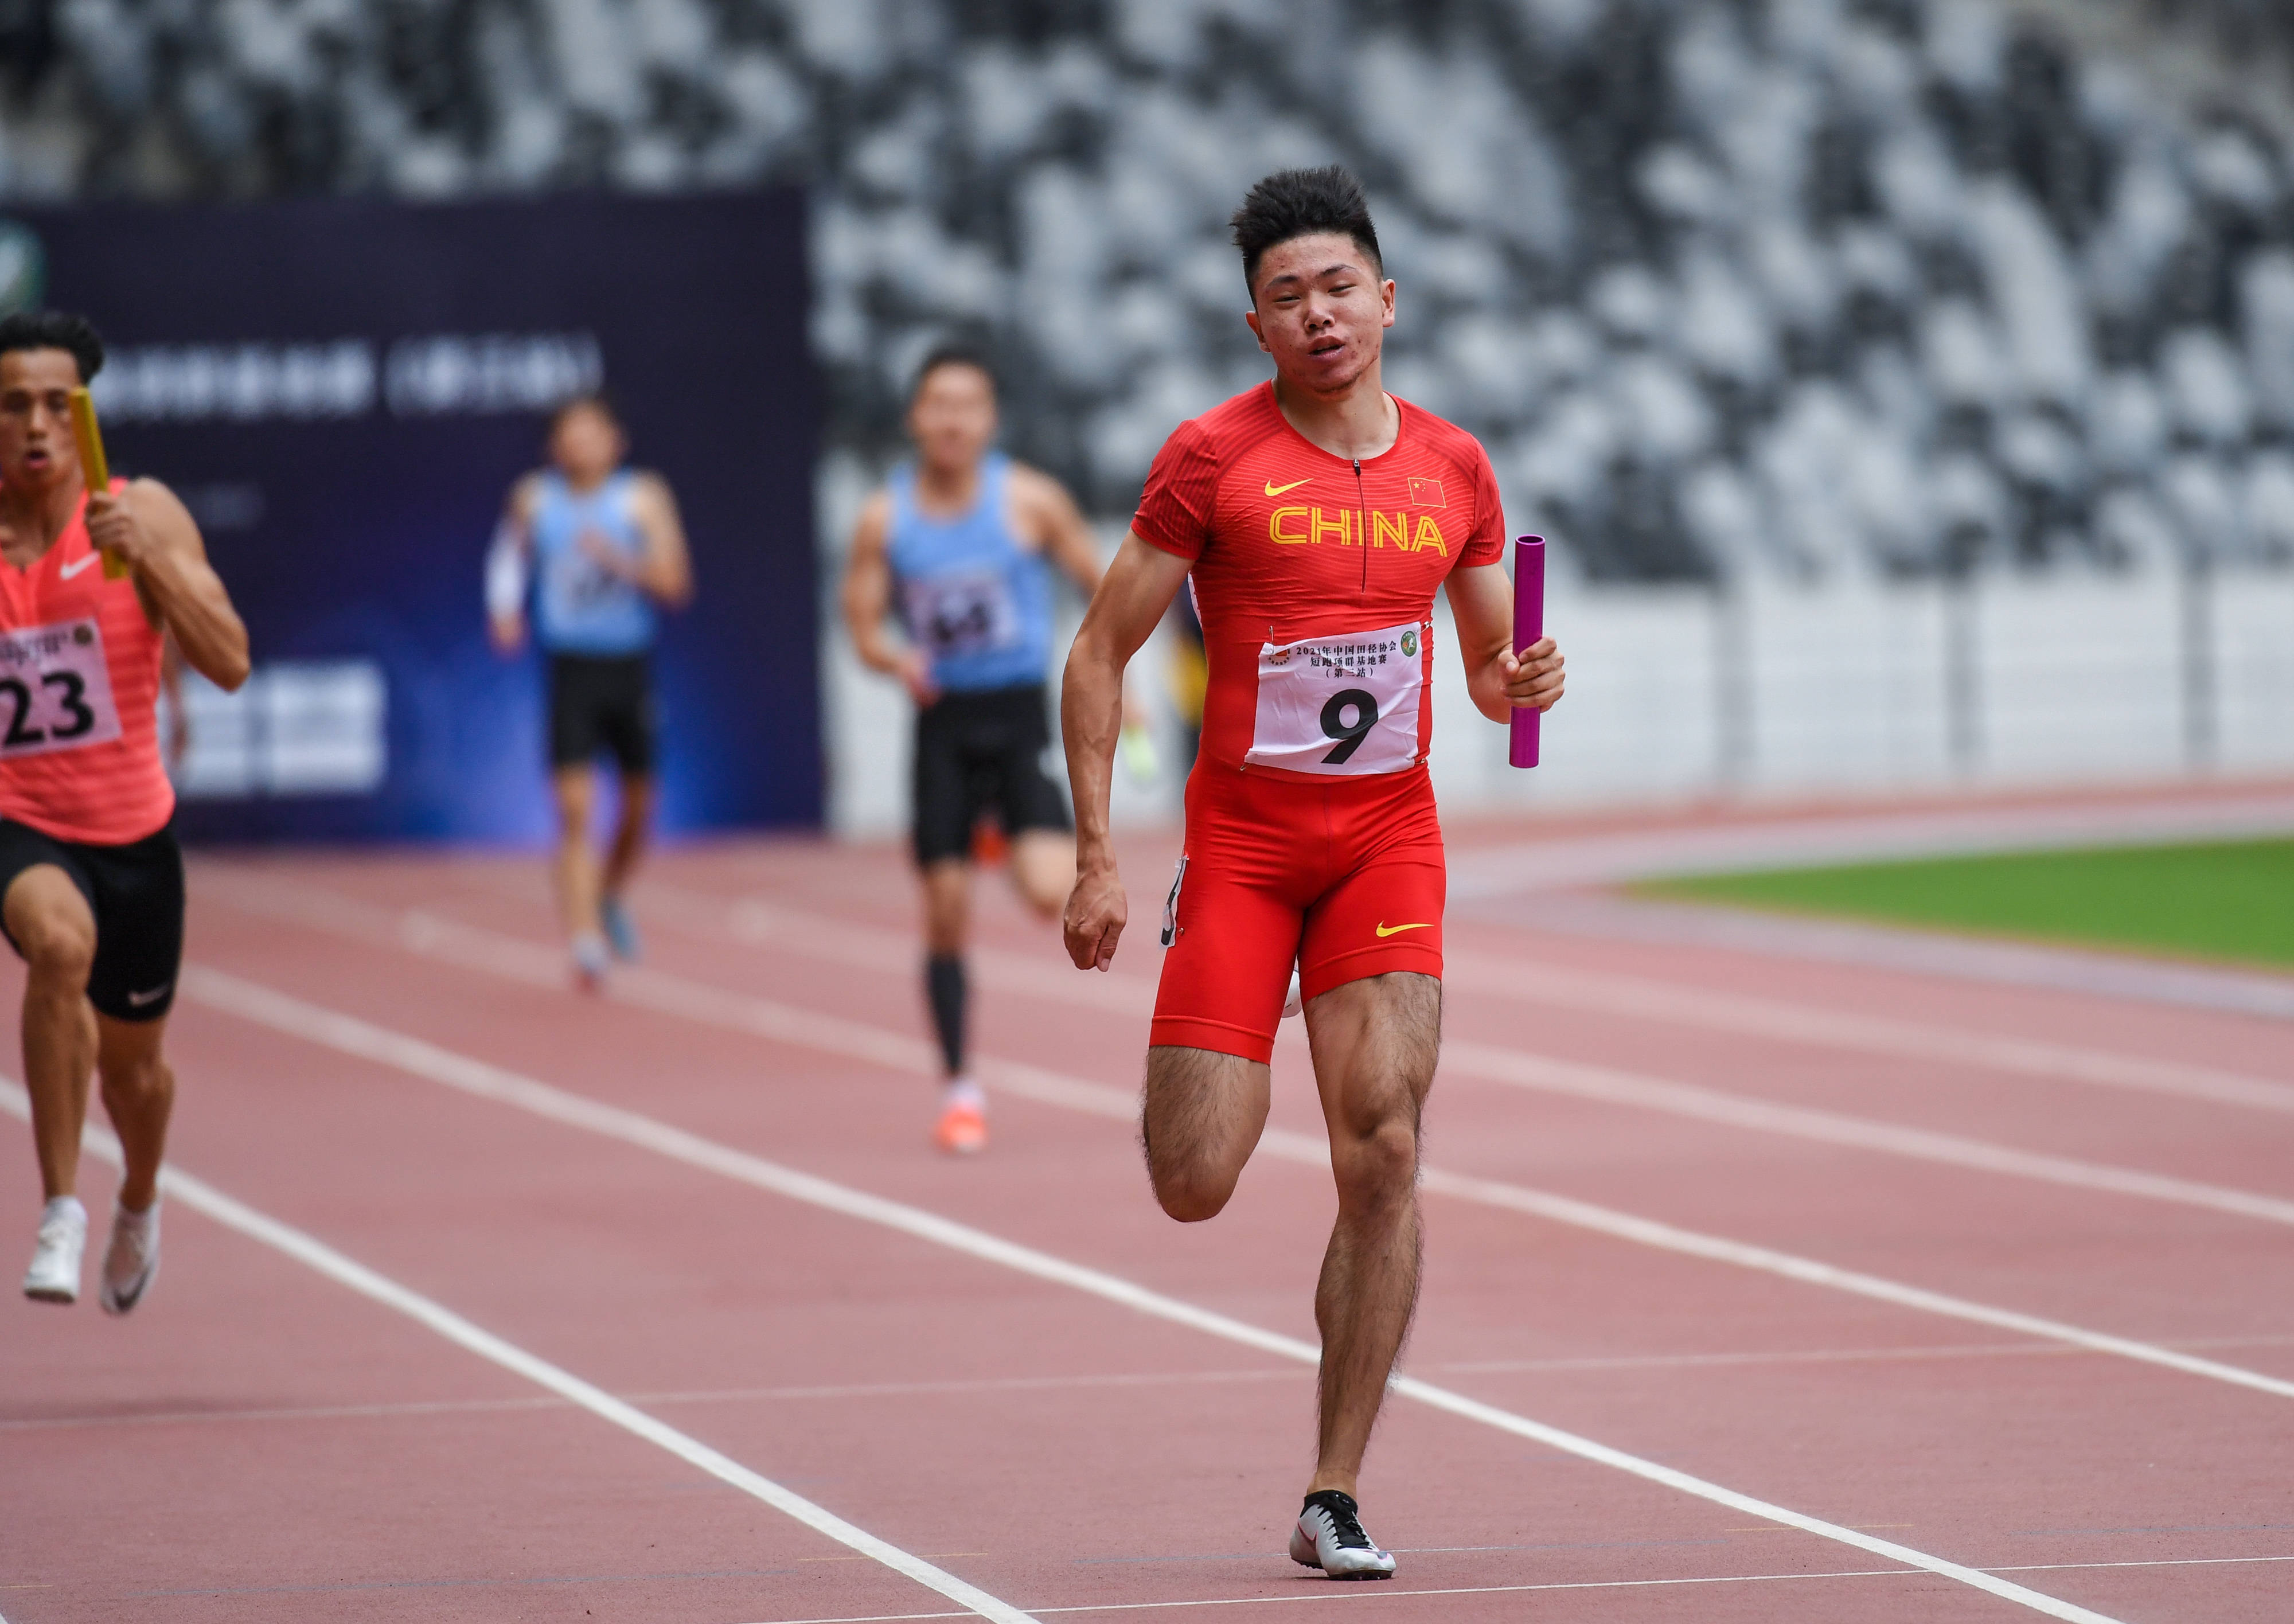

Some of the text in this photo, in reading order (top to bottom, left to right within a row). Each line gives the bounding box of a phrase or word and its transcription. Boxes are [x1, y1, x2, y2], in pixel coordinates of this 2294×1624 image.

[1269, 506, 1448, 557] CHINA
[1296, 641, 1396, 656] 2021年中国田径协会
[1310, 654, 1387, 667] 短跑项群基地赛
[0, 672, 95, 745] 23
[1321, 688, 1378, 764] 9
